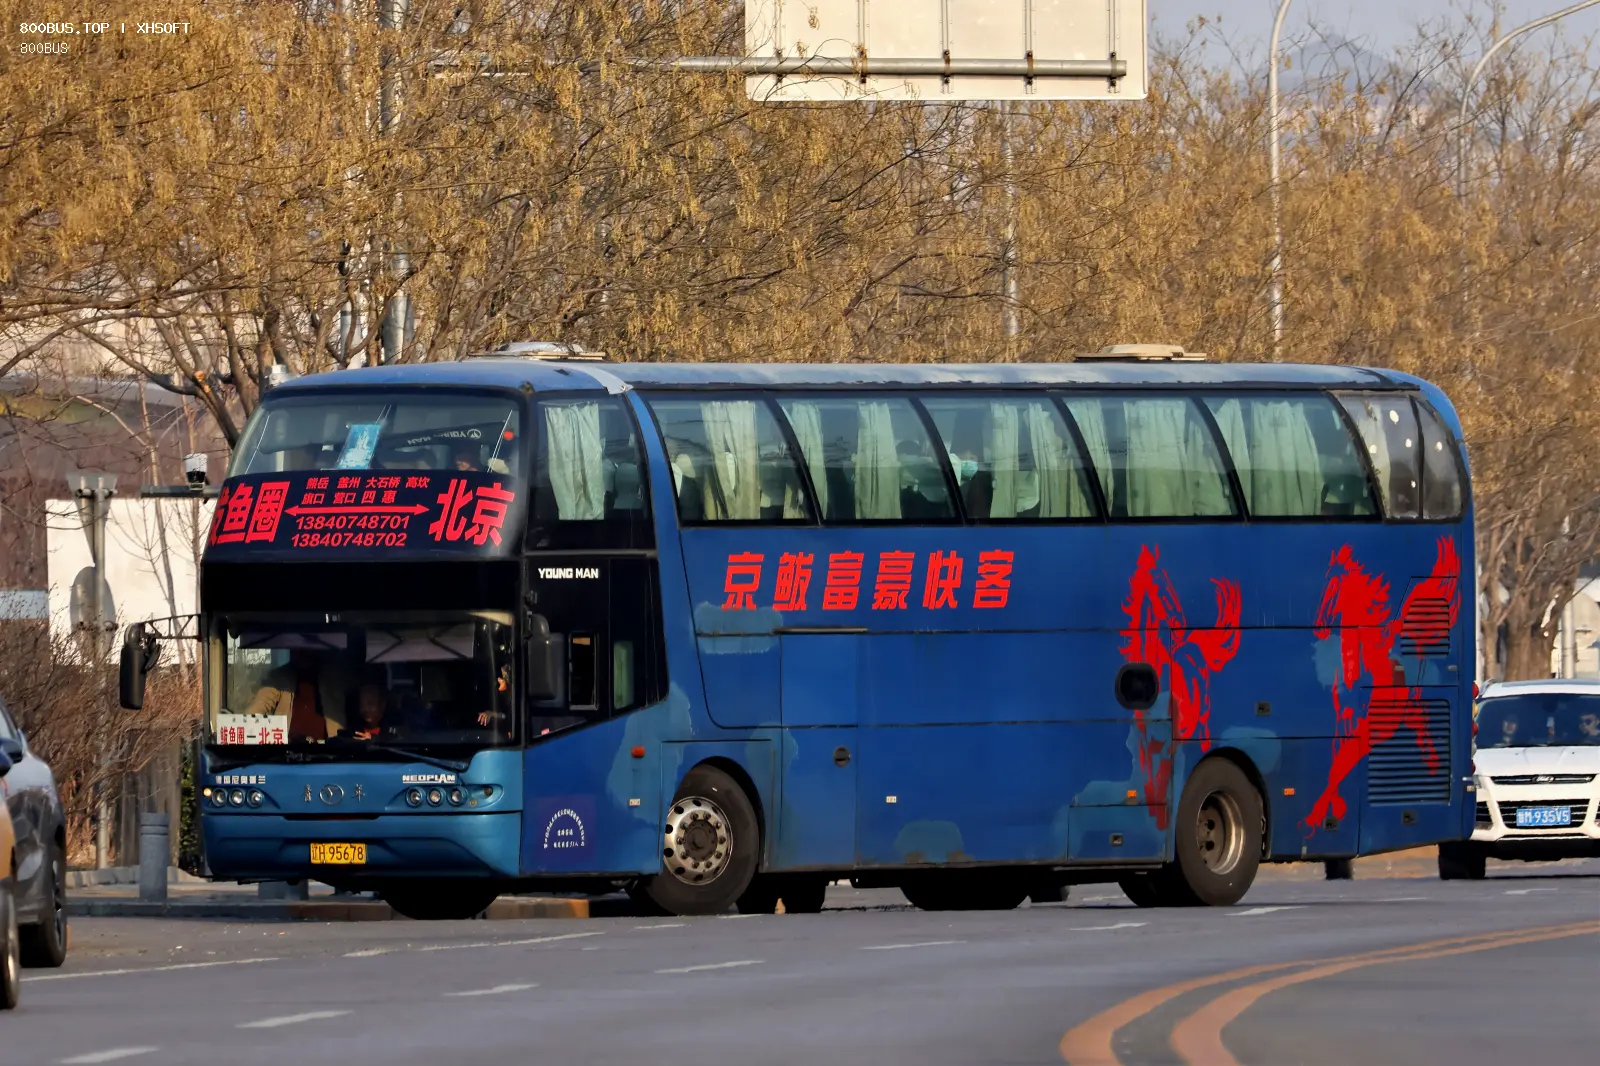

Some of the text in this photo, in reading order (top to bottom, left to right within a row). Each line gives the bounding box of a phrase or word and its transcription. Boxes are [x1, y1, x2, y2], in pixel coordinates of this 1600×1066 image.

[306, 477, 430, 489] 熊岳 盖州 大石桥 高坎
[301, 492, 325, 505] 旗口
[333, 492, 357, 505] 营口
[428, 478, 515, 547] 北京
[295, 515, 410, 530] 13840748701
[291, 532, 407, 547] 13840748702
[537, 567, 599, 579] YOUNG MAN
[402, 773, 456, 784] NEOPLAN
